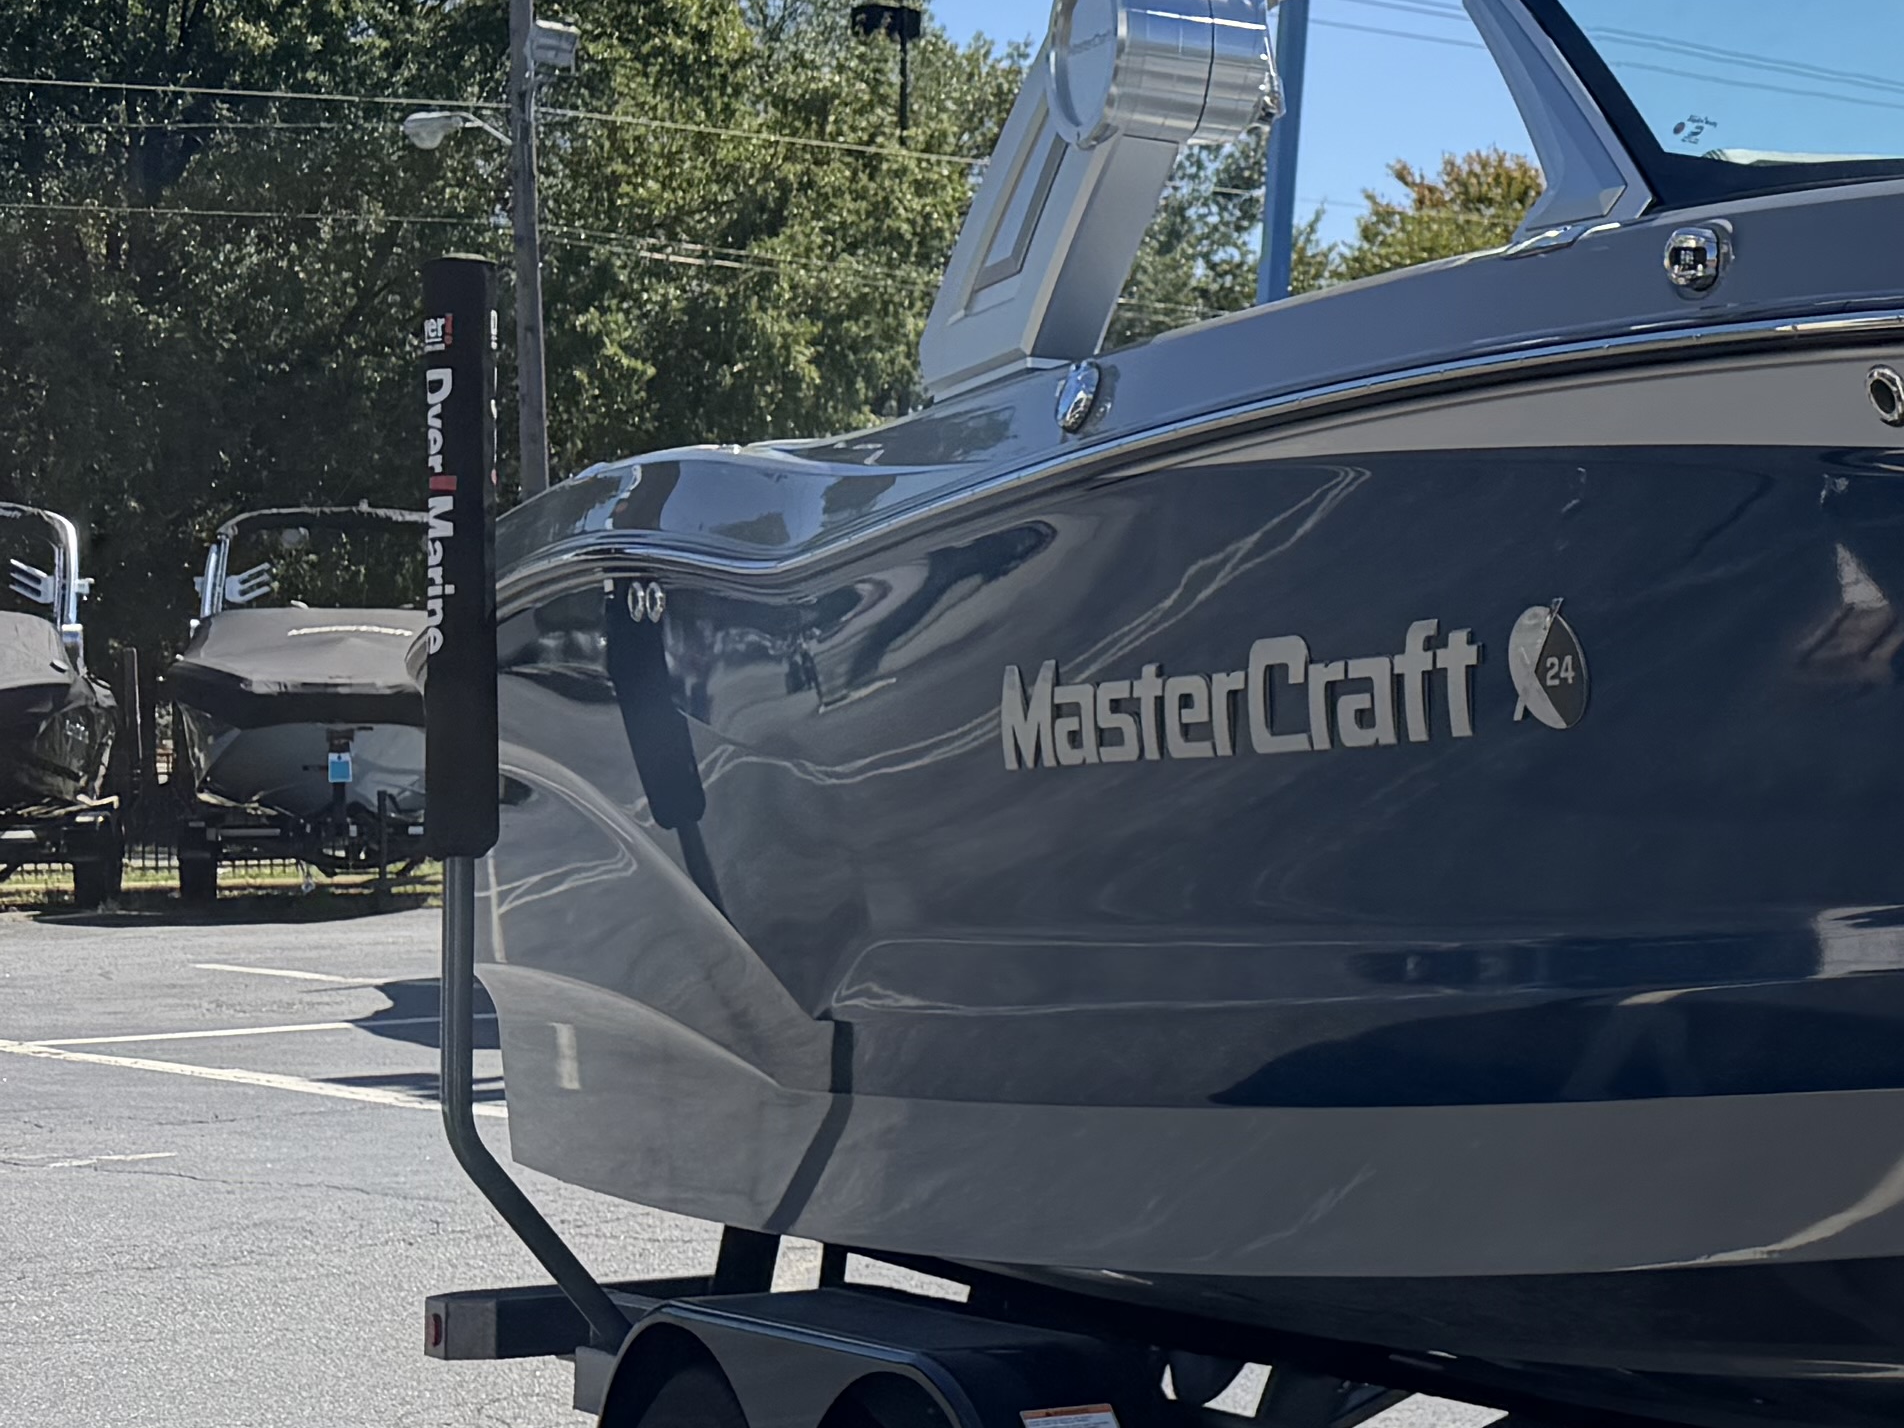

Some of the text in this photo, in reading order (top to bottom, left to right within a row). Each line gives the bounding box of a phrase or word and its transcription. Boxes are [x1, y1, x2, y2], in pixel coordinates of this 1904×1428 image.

[426, 494, 456, 656] Marine
[999, 618, 1483, 771] MasterCraft
[1545, 654, 1576, 687] 24
